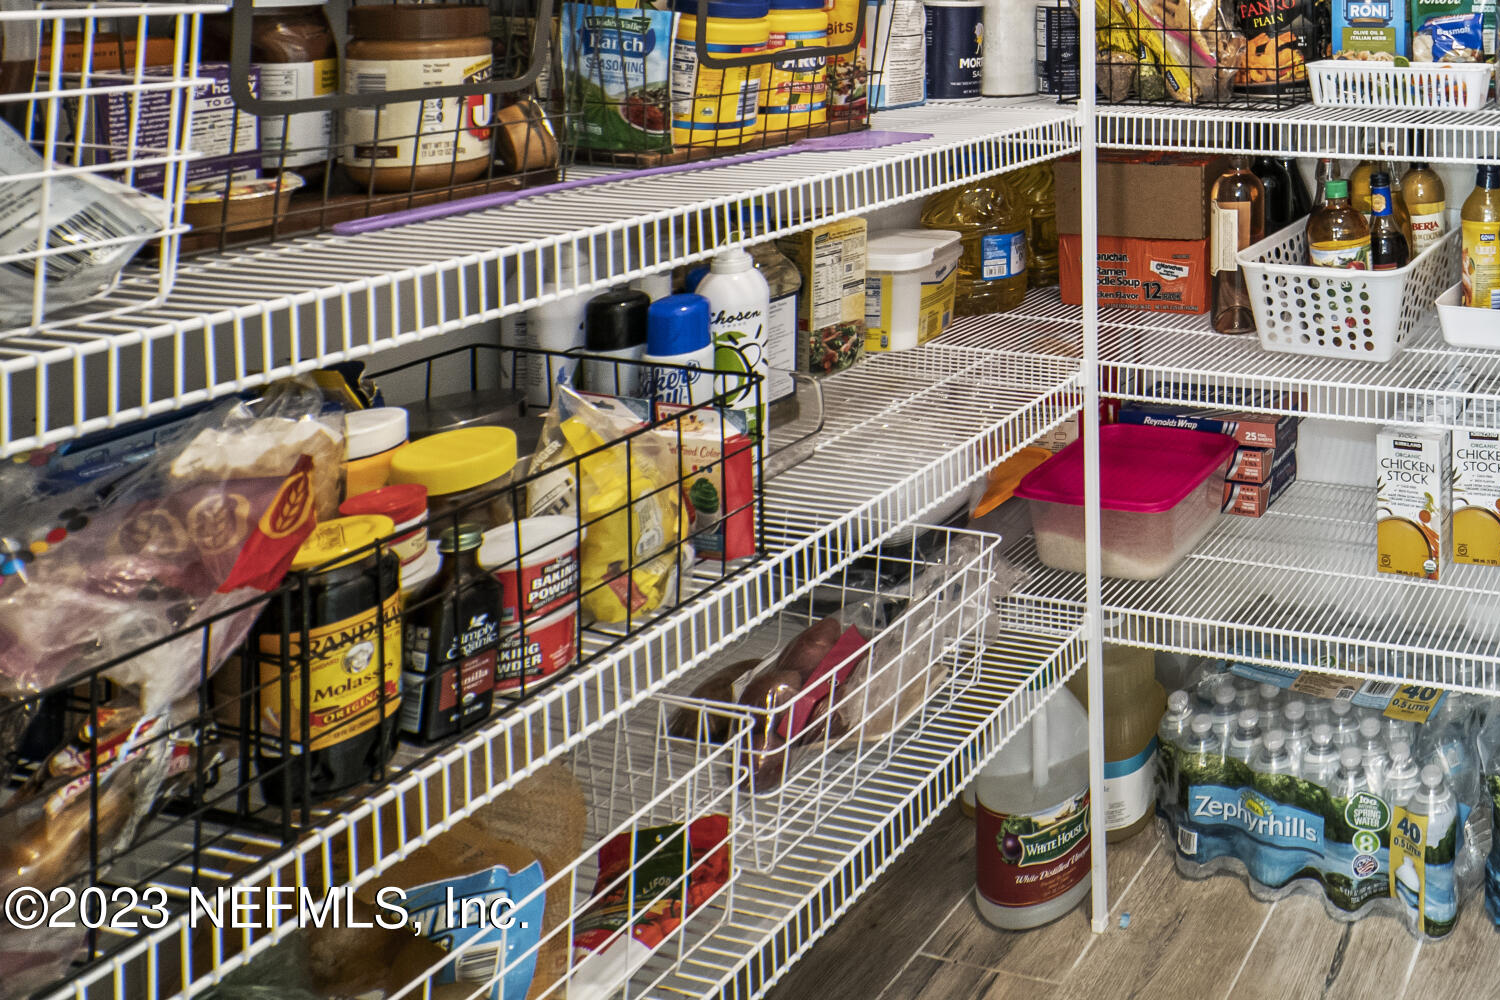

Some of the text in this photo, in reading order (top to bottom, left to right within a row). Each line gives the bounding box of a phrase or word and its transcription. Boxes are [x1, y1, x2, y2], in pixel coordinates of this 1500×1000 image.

[1349, 4, 1388, 18] RONI
[1252, 13, 1285, 28] PLAIN
[1436, 24, 1471, 37] Basmati
[1116, 277, 1141, 290] Soup
[1143, 281, 1162, 300] 12
[1112, 290, 1139, 301] Flavor
[1143, 415, 1198, 431] Reynolds Wrap
[1245, 431, 1257, 441] 25
[1394, 451, 1421, 460] ORGANIC
[1380, 457, 1435, 474] CHICKEN
[1386, 470, 1429, 486] STOCK
[1402, 685, 1438, 701] 40
[1406, 702, 1431, 714] LITER
[1194, 795, 1318, 843] Zephyrhills
[1353, 809, 1381, 820] SPRING
[1354, 817, 1380, 829] WATER
[1396, 816, 1422, 845] 40
[1025, 822, 1083, 857] WHITE HOUSE
[1016, 872, 1040, 885] White
[1039, 859, 1072, 880] Distilled
